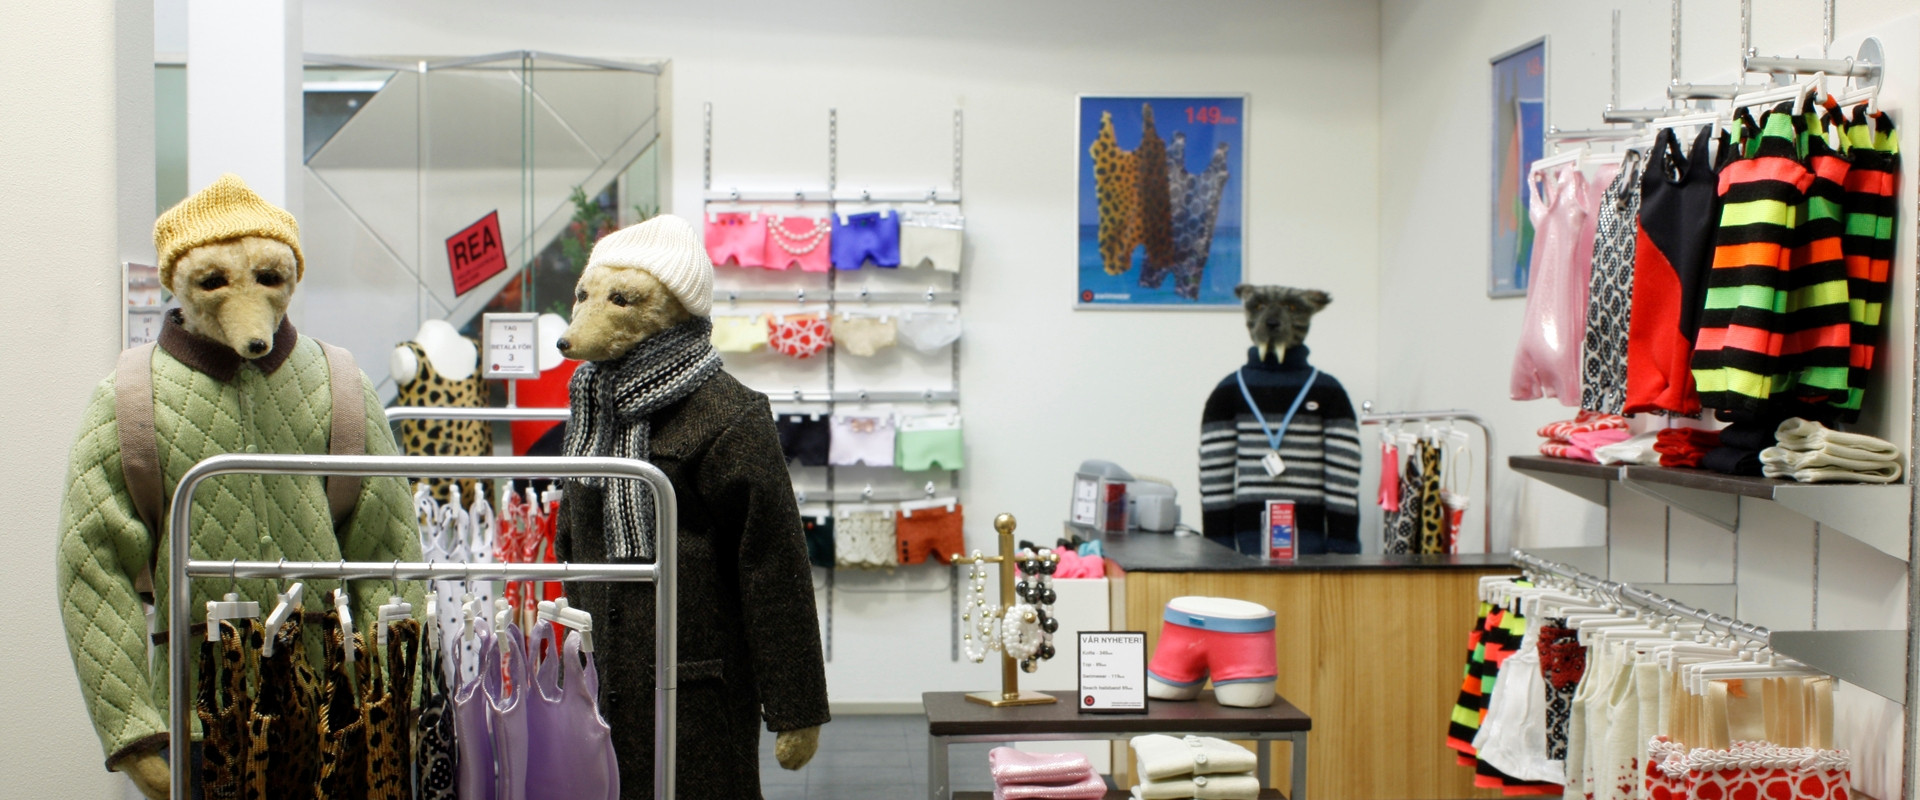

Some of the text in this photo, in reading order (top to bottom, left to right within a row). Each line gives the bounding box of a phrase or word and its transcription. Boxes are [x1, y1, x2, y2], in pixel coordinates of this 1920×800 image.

[453, 224, 496, 270] REA
[508, 334, 514, 343] 2
[508, 353, 514, 362] 3
[1082, 636, 1099, 644] VÅR
